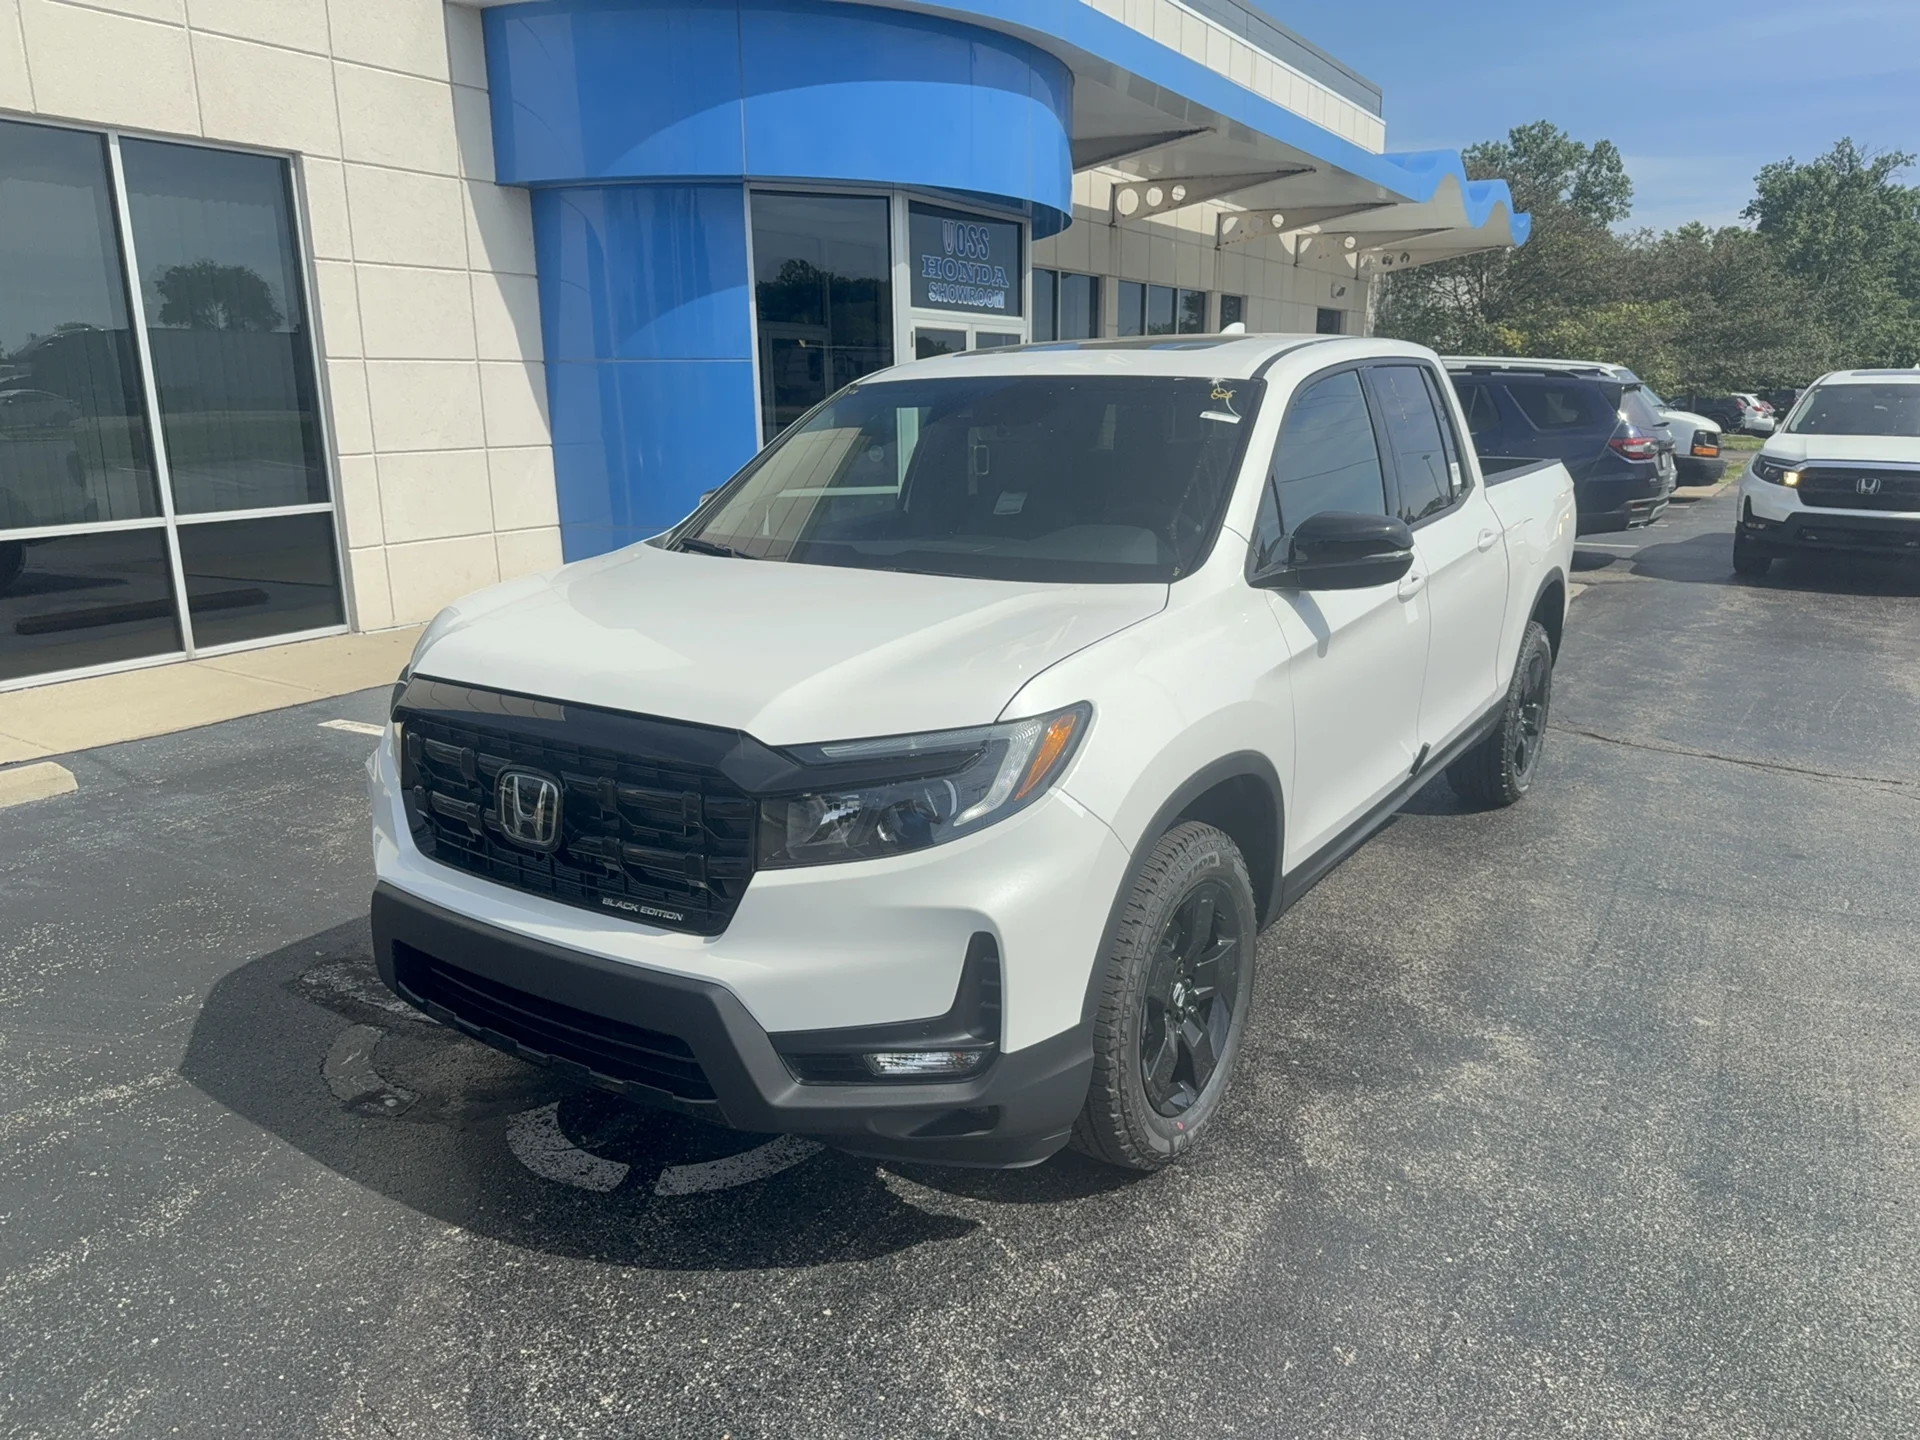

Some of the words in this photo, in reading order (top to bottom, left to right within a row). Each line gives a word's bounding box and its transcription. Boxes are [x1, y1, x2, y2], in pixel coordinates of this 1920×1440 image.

[942, 219, 990, 260] VOSS
[922, 255, 1009, 288] HONDA
[928, 282, 1005, 309] SHOWROOM
[602, 897, 639, 912] BLACK
[640, 906, 684, 921] EDITION
